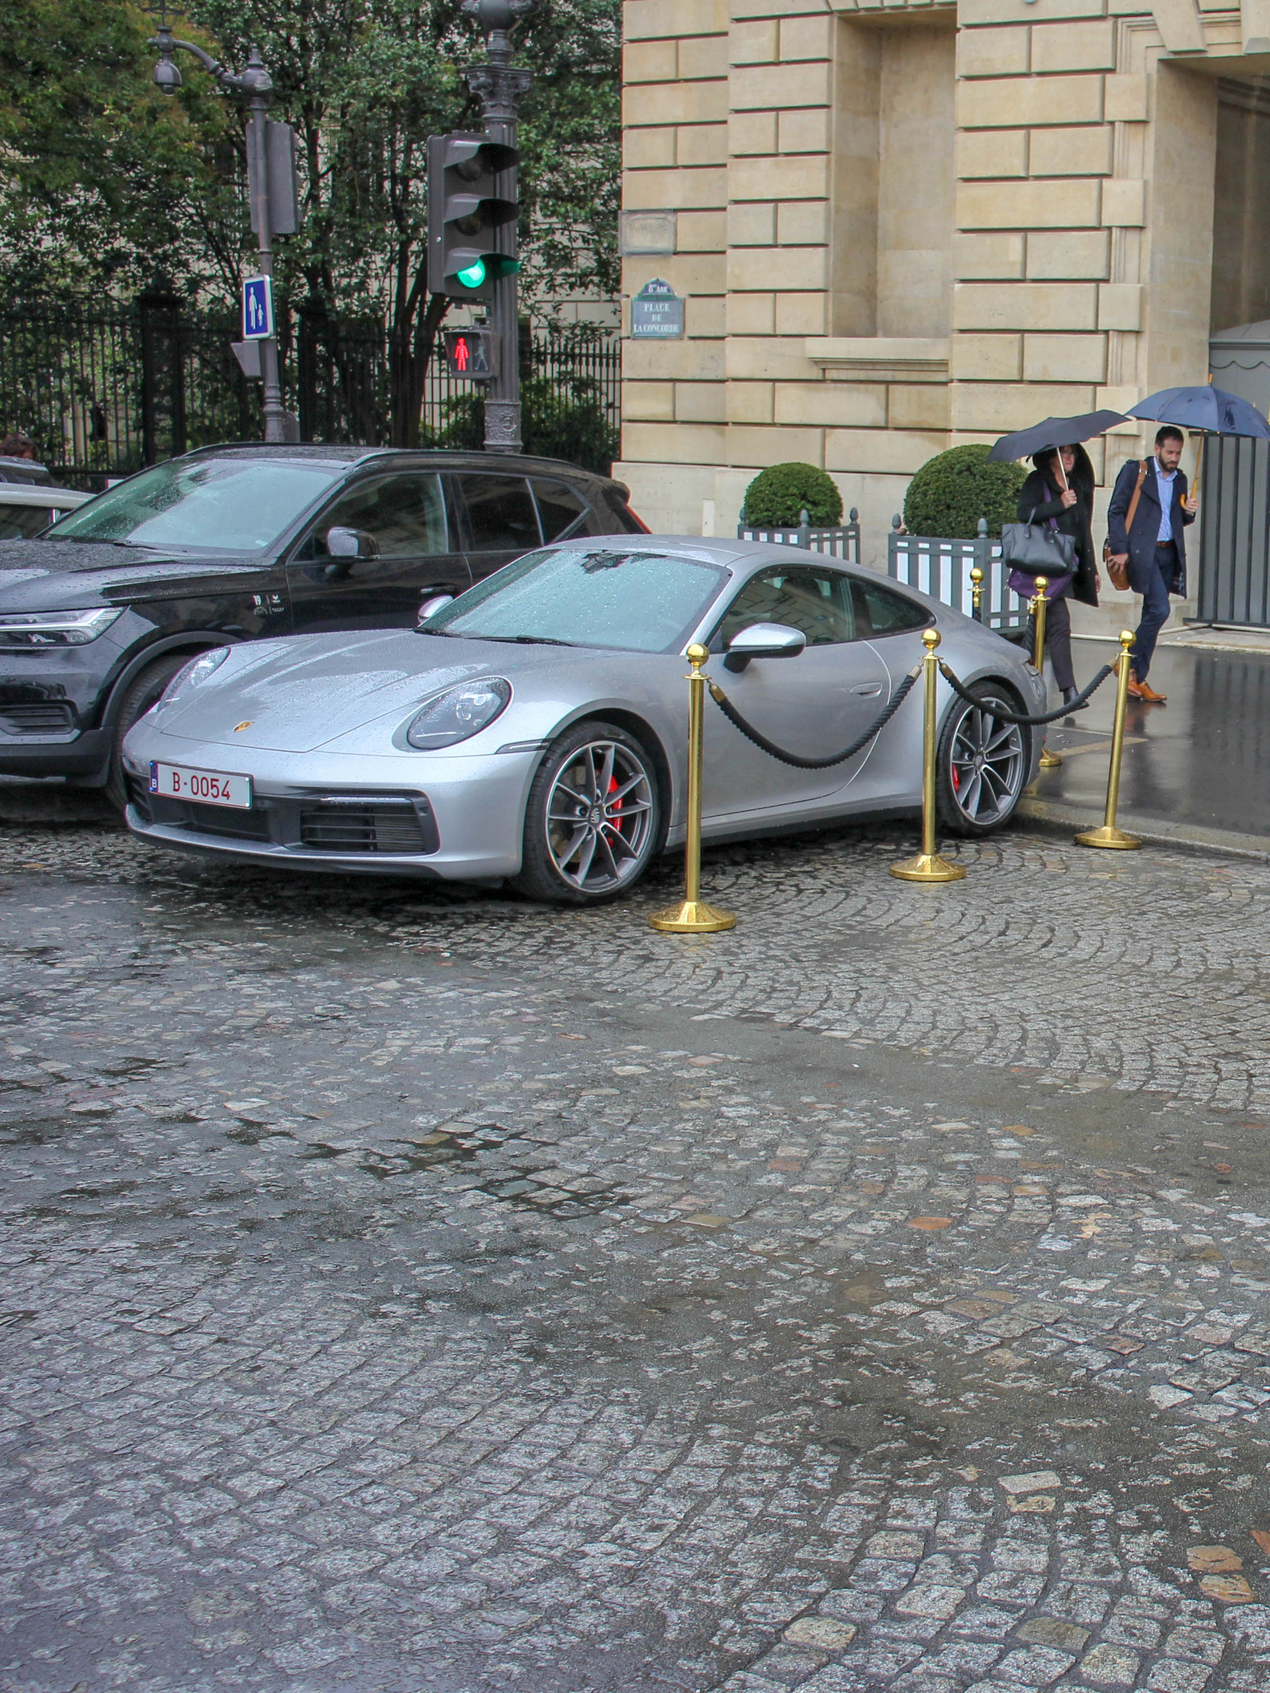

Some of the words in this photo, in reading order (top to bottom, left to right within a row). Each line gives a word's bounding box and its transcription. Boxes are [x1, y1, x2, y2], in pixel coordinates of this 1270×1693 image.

[644, 303, 670, 312] PLACE
[633, 324, 643, 333] LA
[643, 324, 680, 333] CONCORDE
[152, 778, 157, 788] B
